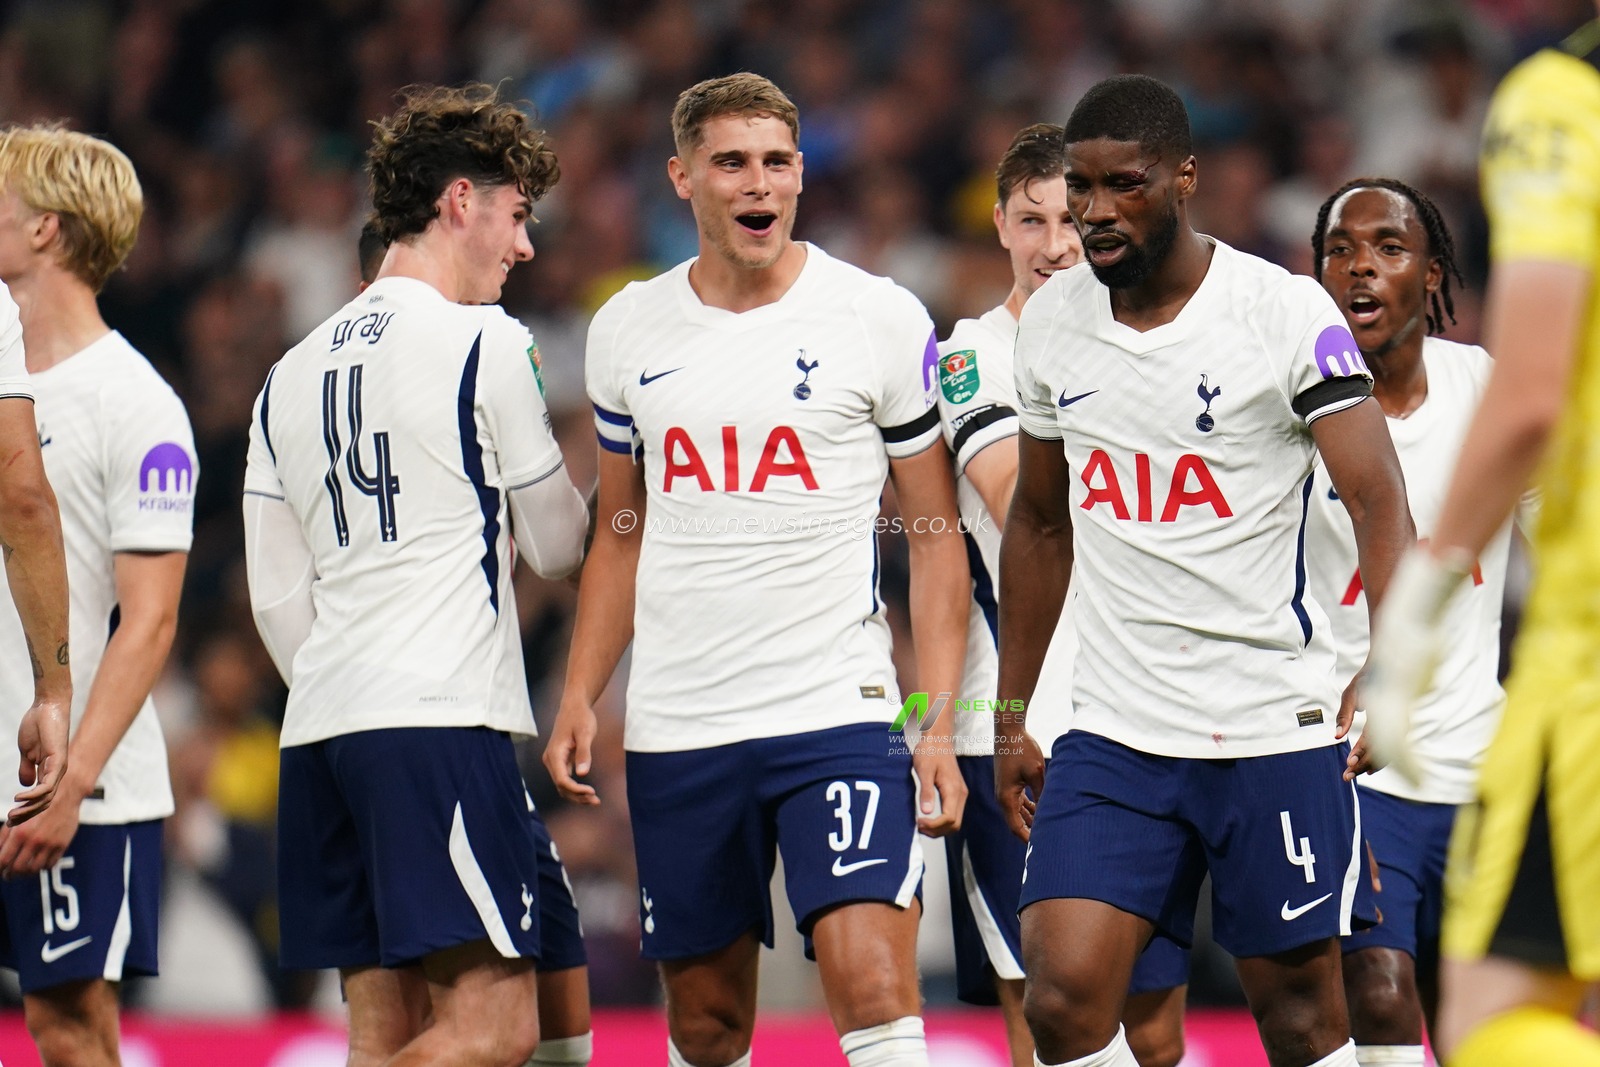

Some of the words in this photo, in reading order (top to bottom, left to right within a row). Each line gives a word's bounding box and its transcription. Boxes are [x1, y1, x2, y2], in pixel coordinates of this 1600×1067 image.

[330, 311, 396, 352] gray
[322, 364, 400, 547] 14
[662, 425, 820, 493] AIA
[1080, 449, 1234, 523] AIA
[825, 780, 881, 852] 37
[1280, 810, 1317, 884] 4
[40, 856, 80, 934] 15
